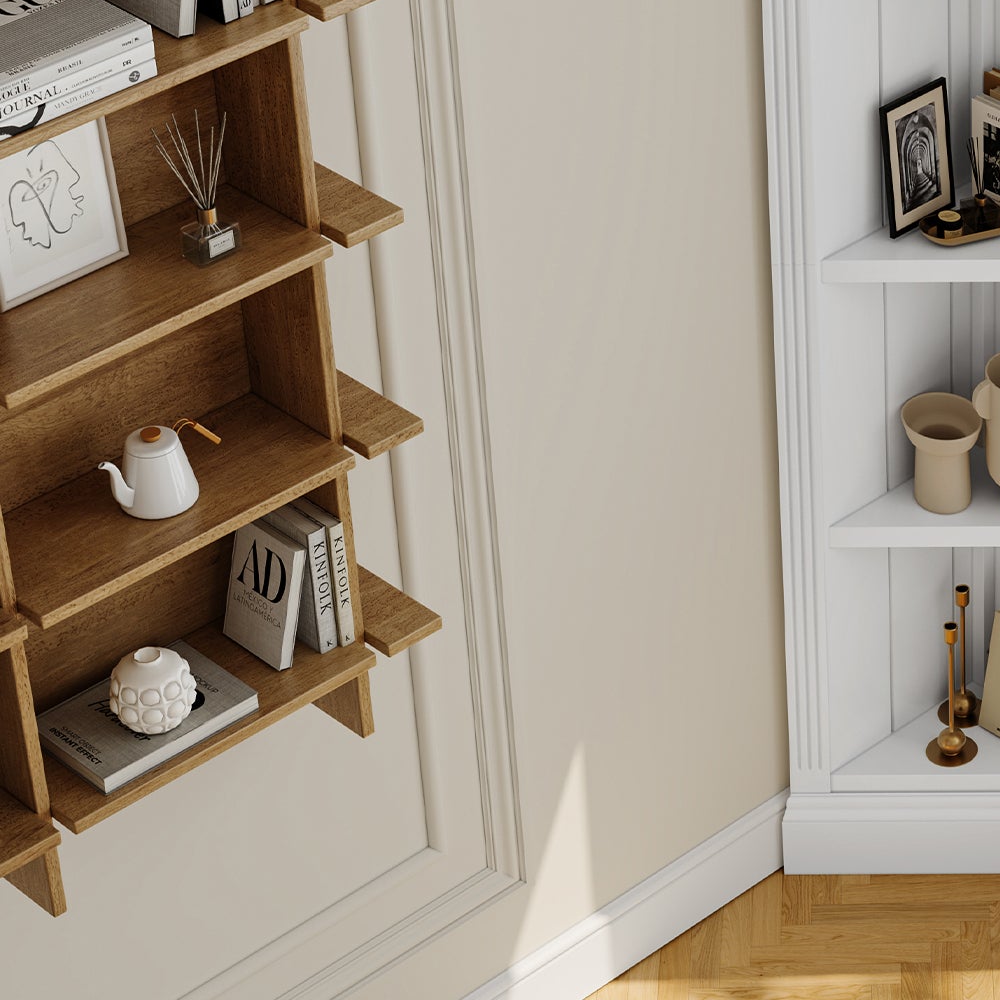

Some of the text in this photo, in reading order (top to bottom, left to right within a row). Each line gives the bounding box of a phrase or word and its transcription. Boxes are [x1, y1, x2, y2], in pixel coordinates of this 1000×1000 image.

[237, 539, 286, 604] AD
[313, 541, 332, 615] KINFOLK
[334, 535, 350, 608] KINFOLK
[49, 727, 103, 765] INSTANT EFFECT
